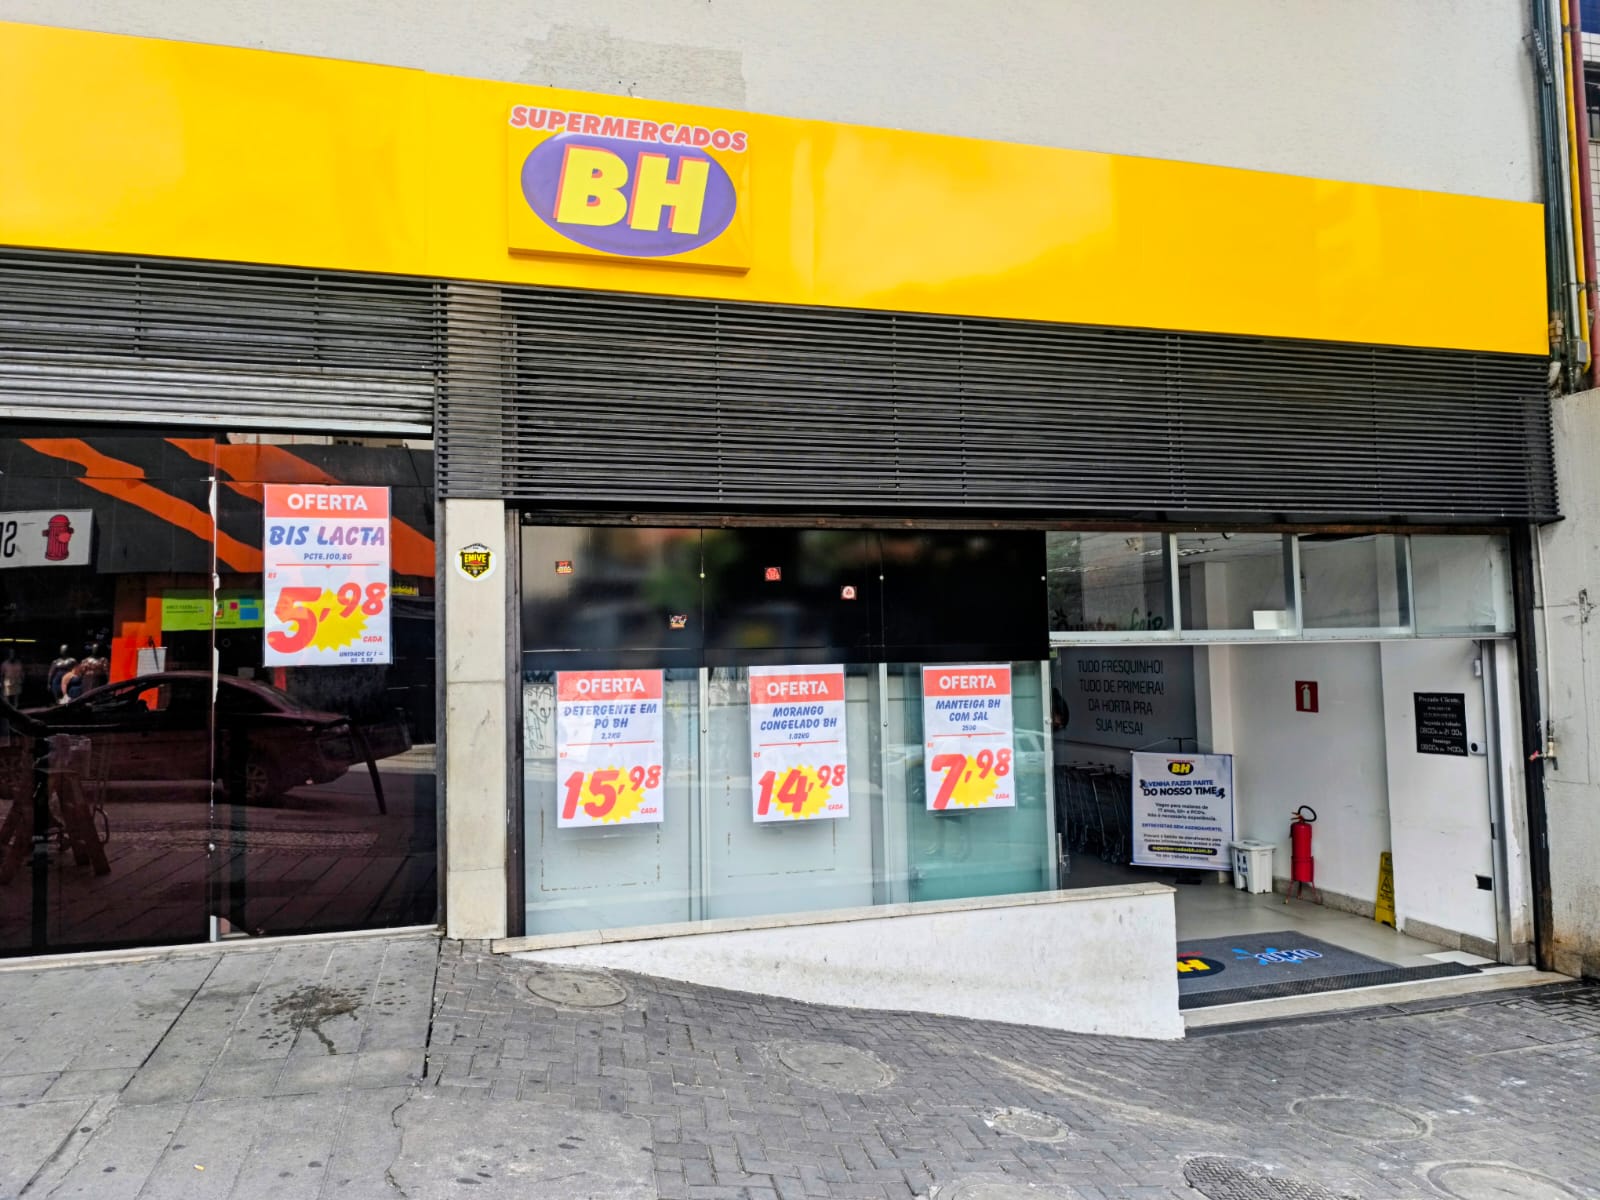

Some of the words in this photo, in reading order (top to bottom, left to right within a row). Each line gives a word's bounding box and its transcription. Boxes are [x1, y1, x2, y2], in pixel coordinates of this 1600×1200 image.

[510, 105, 748, 152] SUPERMERCADOS
[553, 143, 710, 235] BH
[287, 493, 368, 511] OFERTA
[269, 525, 310, 545] BIS
[316, 526, 385, 546] LACTA
[267, 582, 388, 653] 5,98
[363, 635, 383, 643] CADA
[1078, 660, 1100, 673] TUDO
[1101, 660, 1164, 675] FRESQUINHO!
[576, 678, 645, 694] OFERTA
[767, 680, 829, 697] OFERTA
[939, 675, 996, 690] OFERTA
[1080, 679, 1101, 693] TUDO
[1103, 680, 1115, 693] DE
[1117, 680, 1164, 695] PRIMEIRA!
[564, 703, 637, 717] DETERGENTE
[640, 703, 657, 714] EM
[772, 706, 824, 717] MORANGO
[936, 699, 985, 710] MANTEIGA
[987, 699, 1001, 709] BH
[1088, 698, 1100, 711] DA
[1102, 699, 1132, 713] HORTA
[1133, 701, 1153, 715] PRA
[594, 715, 609, 728] PÓ
[613, 718, 629, 728] BH
[760, 719, 820, 731] CONGELADO
[823, 718, 837, 728] BH
[949, 712, 970, 722] COM
[972, 712, 989, 721] SAL
[1096, 718, 1113, 732] SUA
[1115, 720, 1144, 736] MESA!
[1172, 763, 1190, 773] BH
[931, 748, 1012, 810] 7,98
[562, 764, 662, 819] 15,98
[757, 764, 846, 815] 14,98
[1143, 788, 1158, 796] DO
[1159, 787, 1192, 796] NOSSO
[1194, 786, 1217, 795] TIME
[1176, 958, 1211, 973] H
